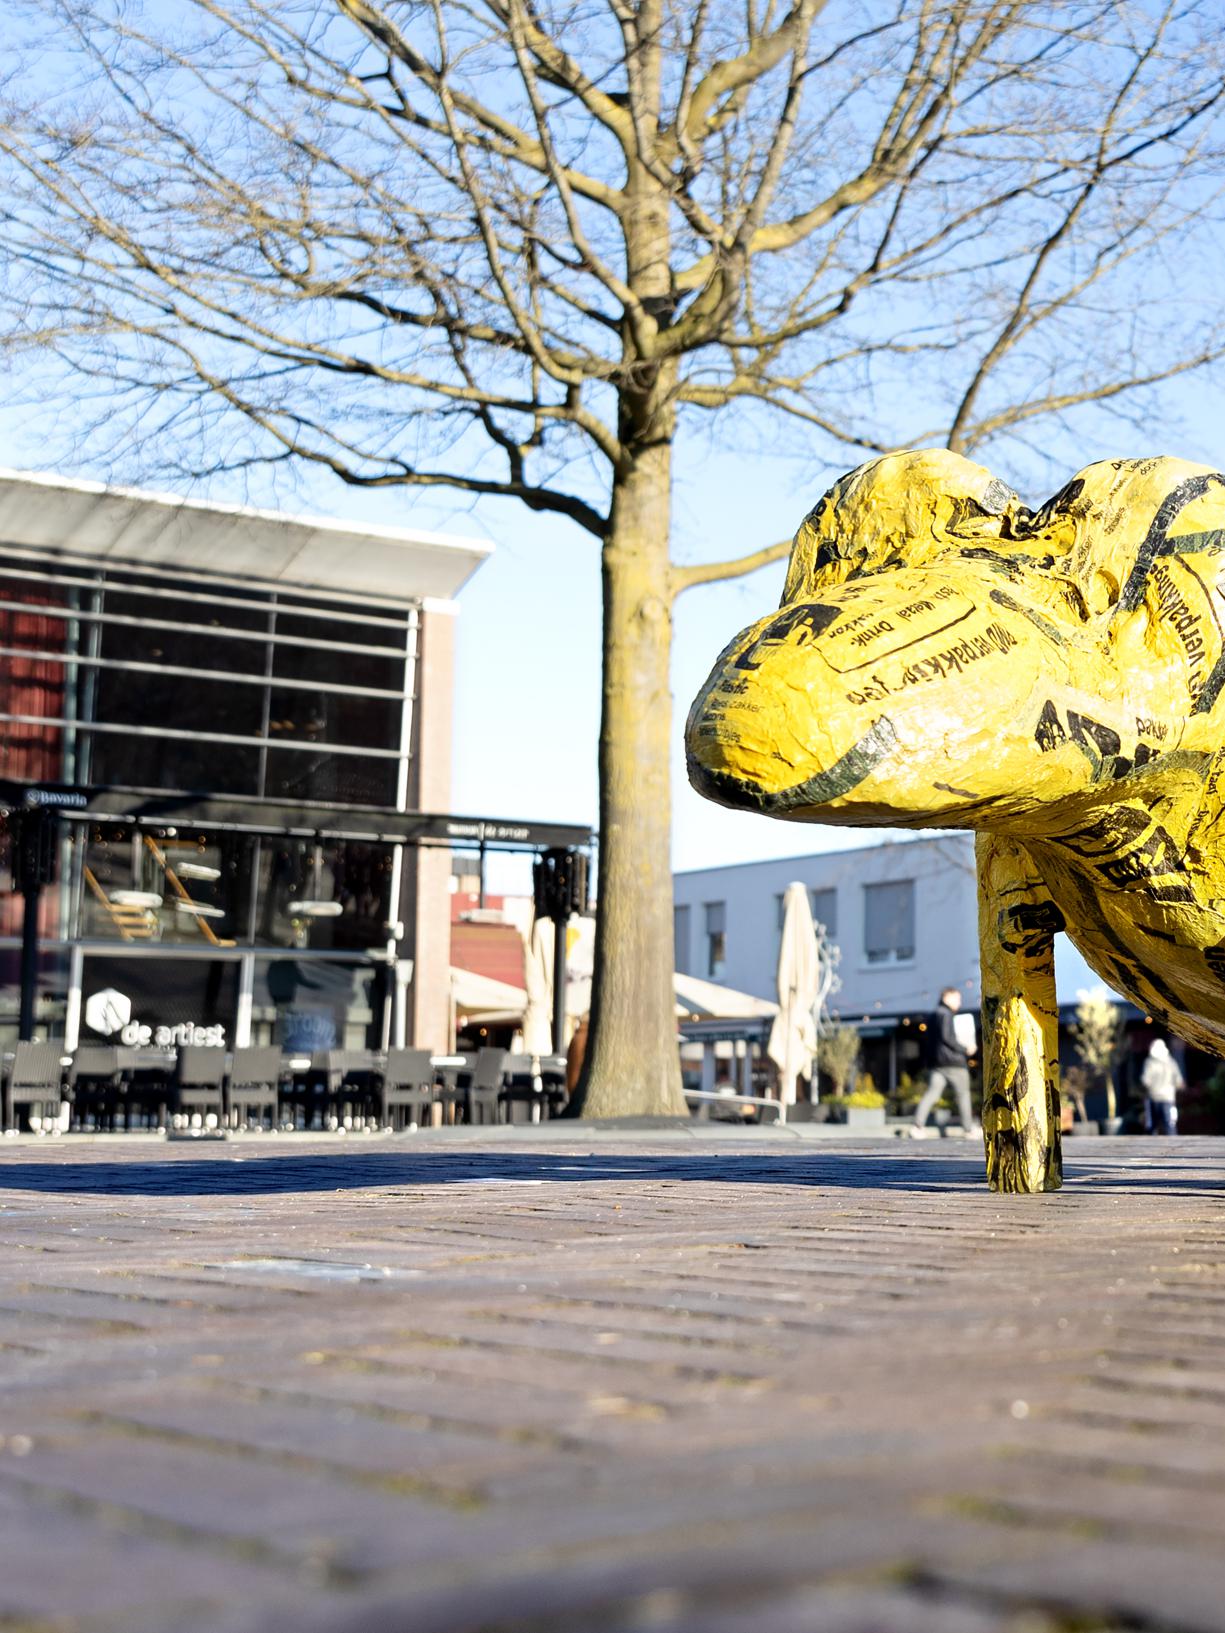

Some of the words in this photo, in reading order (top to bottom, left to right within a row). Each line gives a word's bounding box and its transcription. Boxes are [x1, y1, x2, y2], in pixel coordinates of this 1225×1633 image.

[40, 791, 88, 807] Bavaria
[121, 1020, 152, 1046] de
[155, 1021, 225, 1047] artiest
